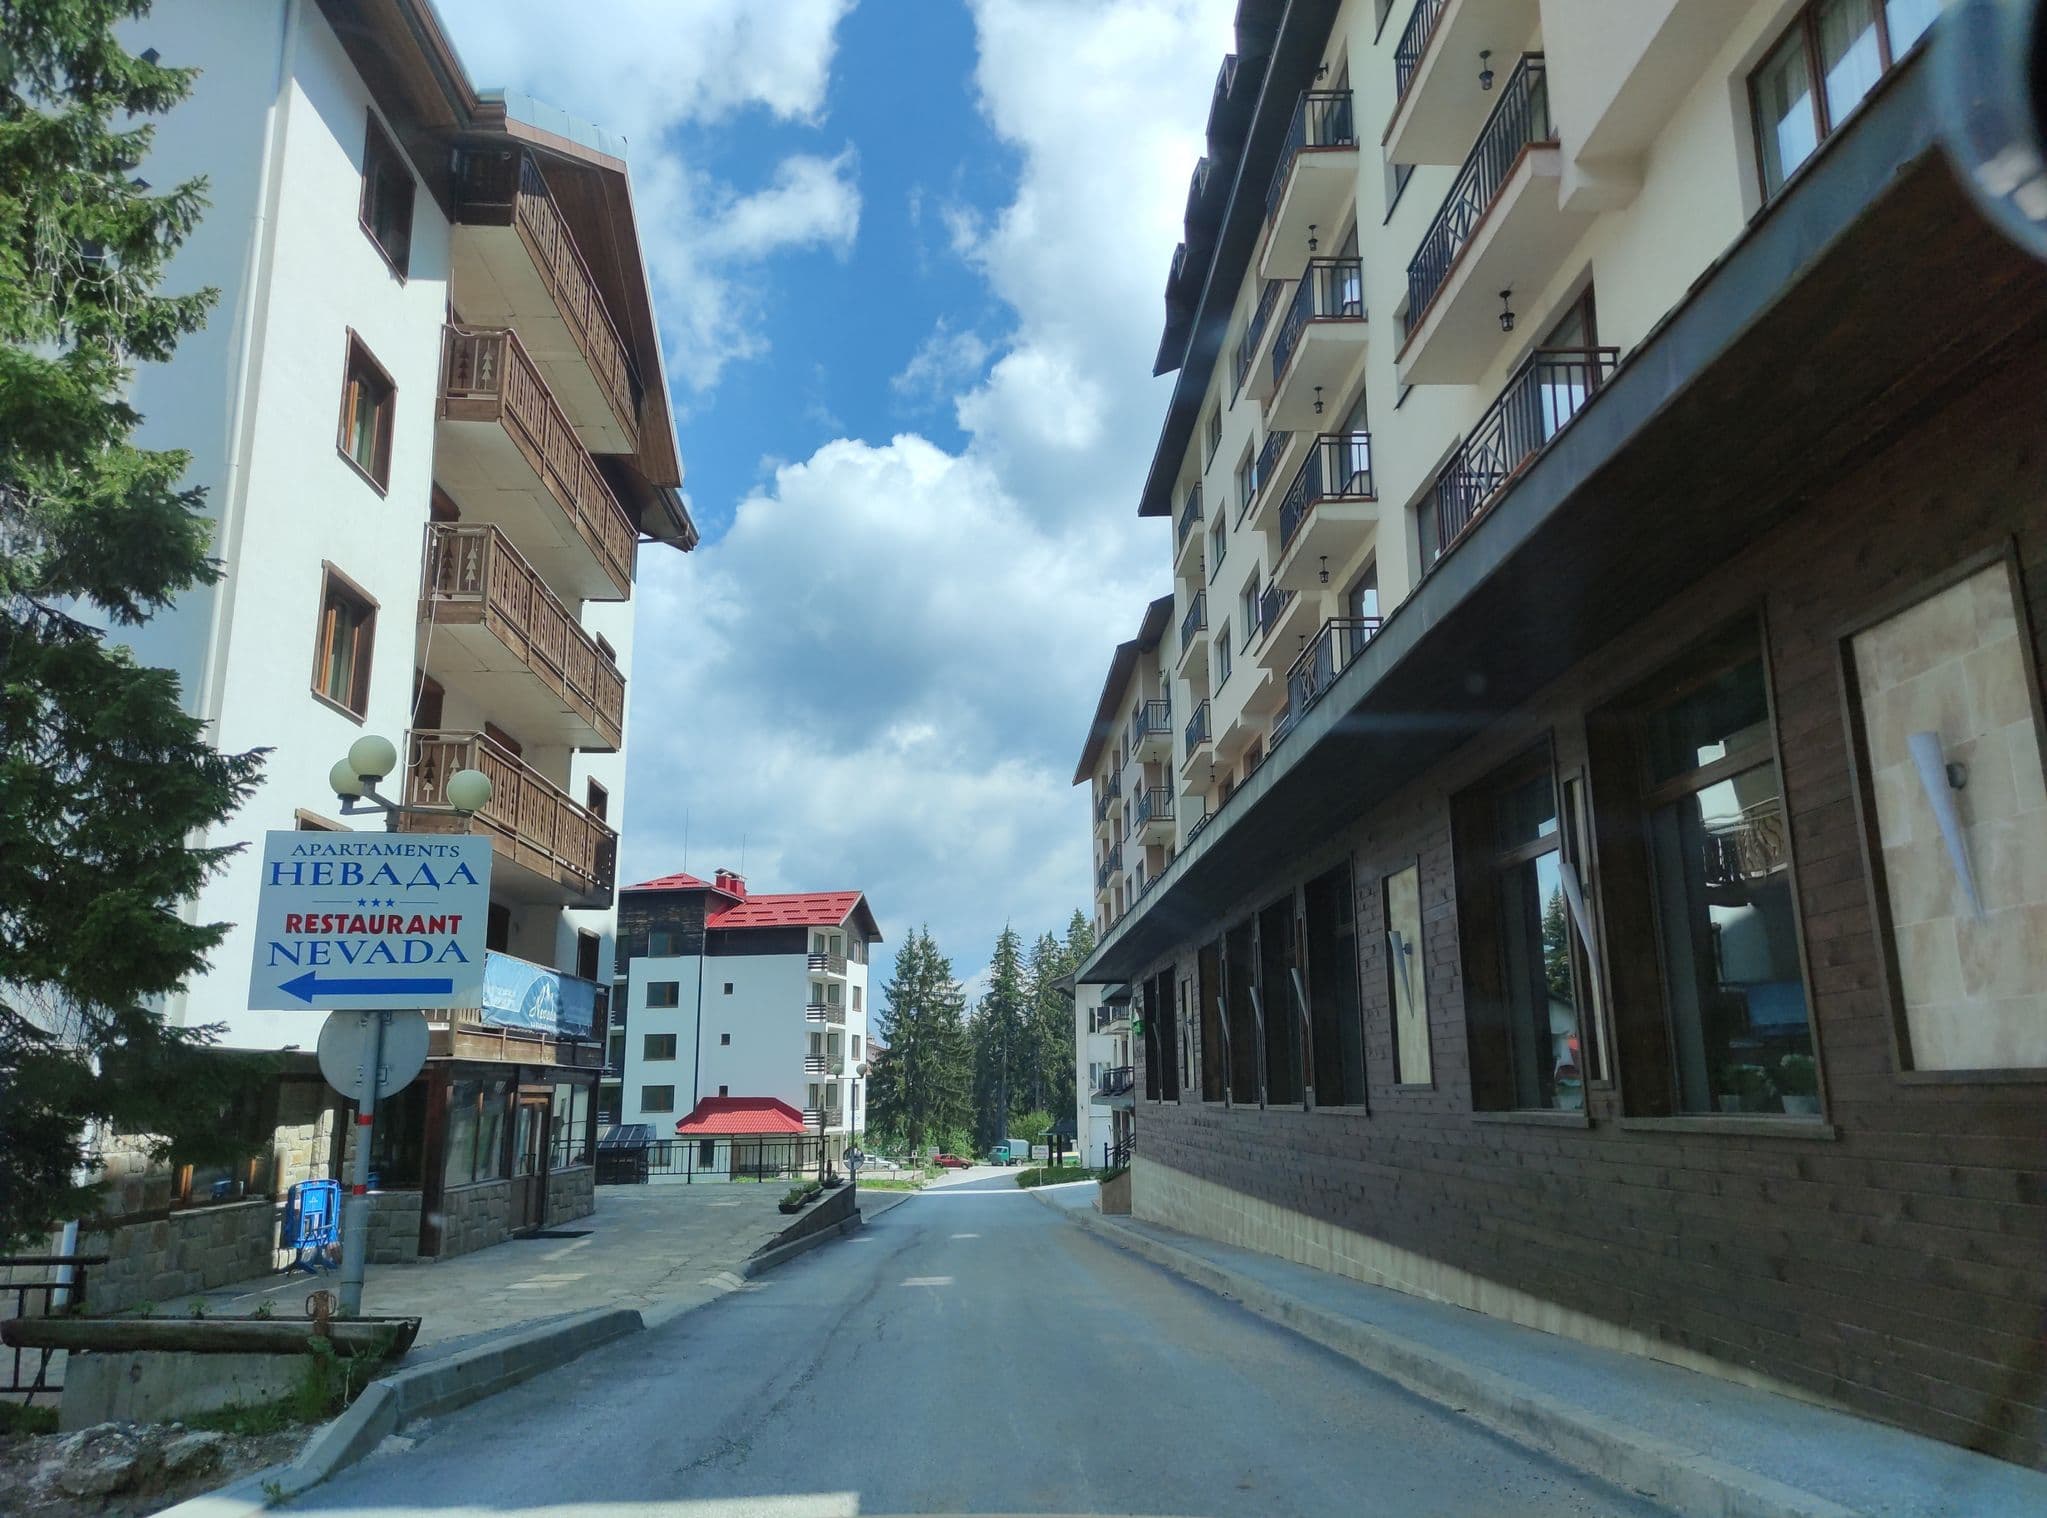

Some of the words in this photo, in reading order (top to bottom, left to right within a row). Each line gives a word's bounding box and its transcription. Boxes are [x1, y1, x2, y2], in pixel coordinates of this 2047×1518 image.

[291, 844, 460, 857] APARTAMENTS
[268, 862, 479, 890] НЕВАДА
[285, 914, 462, 934] RESTAURANT
[267, 940, 470, 966] NEVADA
